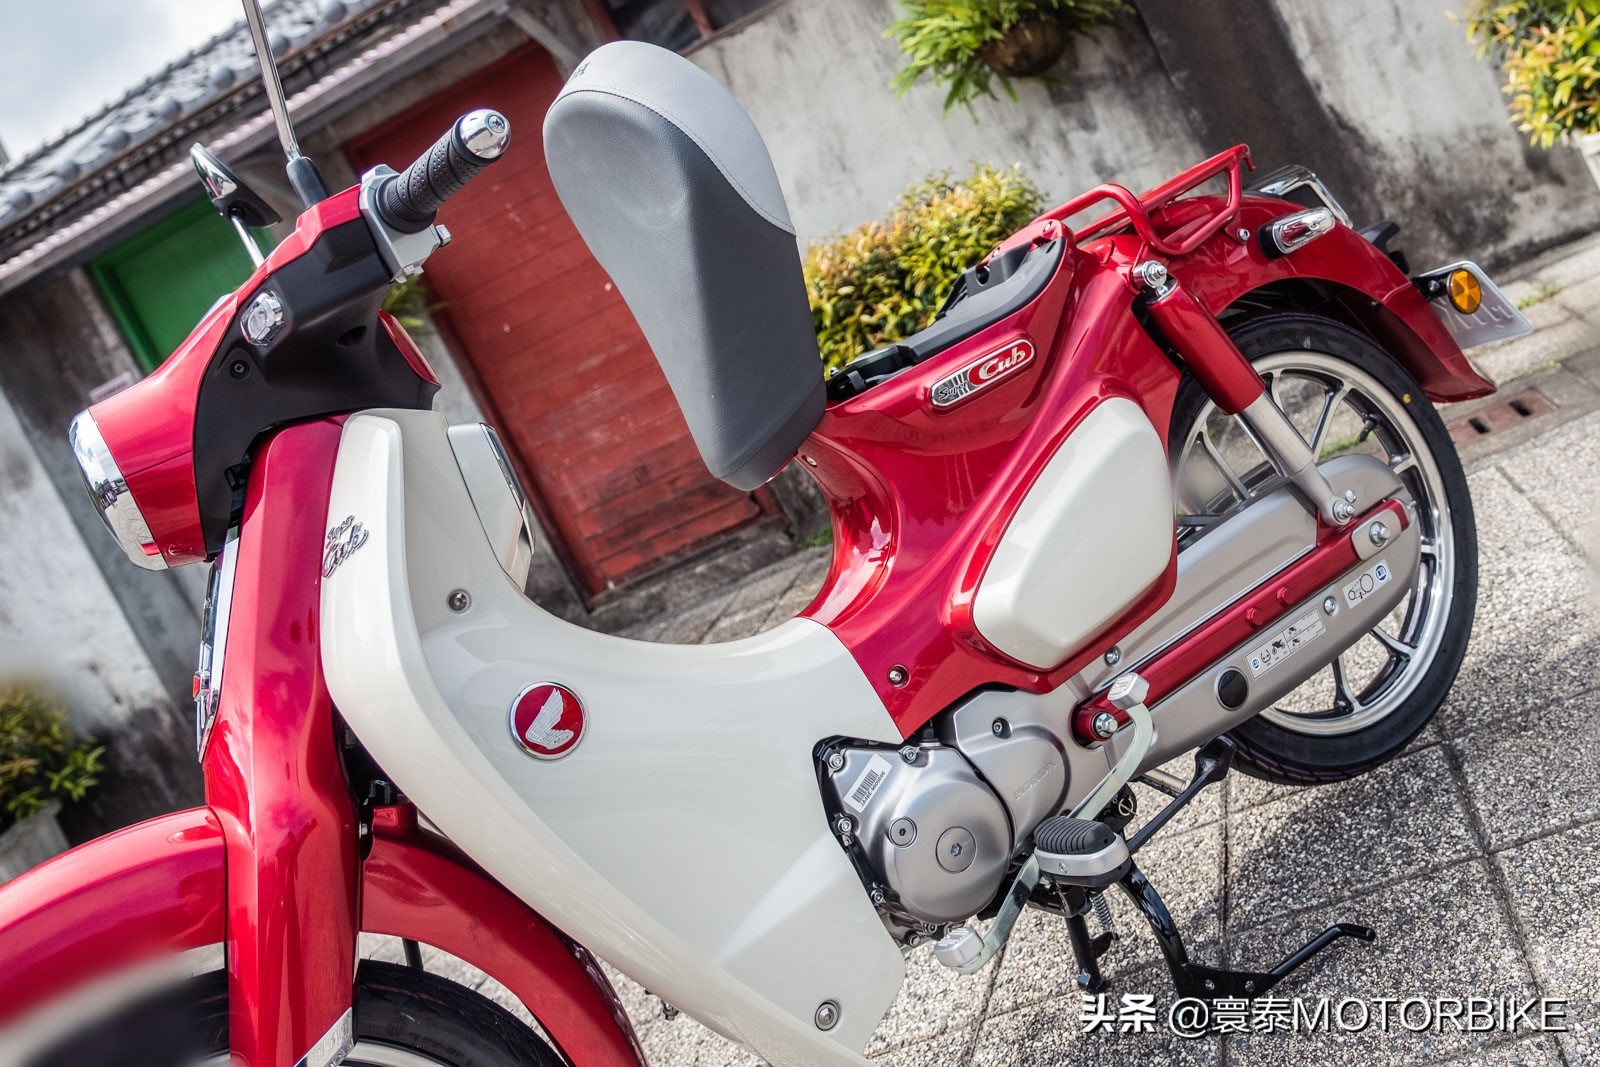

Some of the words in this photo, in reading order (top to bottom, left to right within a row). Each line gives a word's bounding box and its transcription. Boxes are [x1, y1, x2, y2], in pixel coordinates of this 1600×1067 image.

[978, 346, 1026, 380] Cub
[322, 522, 369, 579] Cub
[1013, 761, 1057, 800] HONDA
